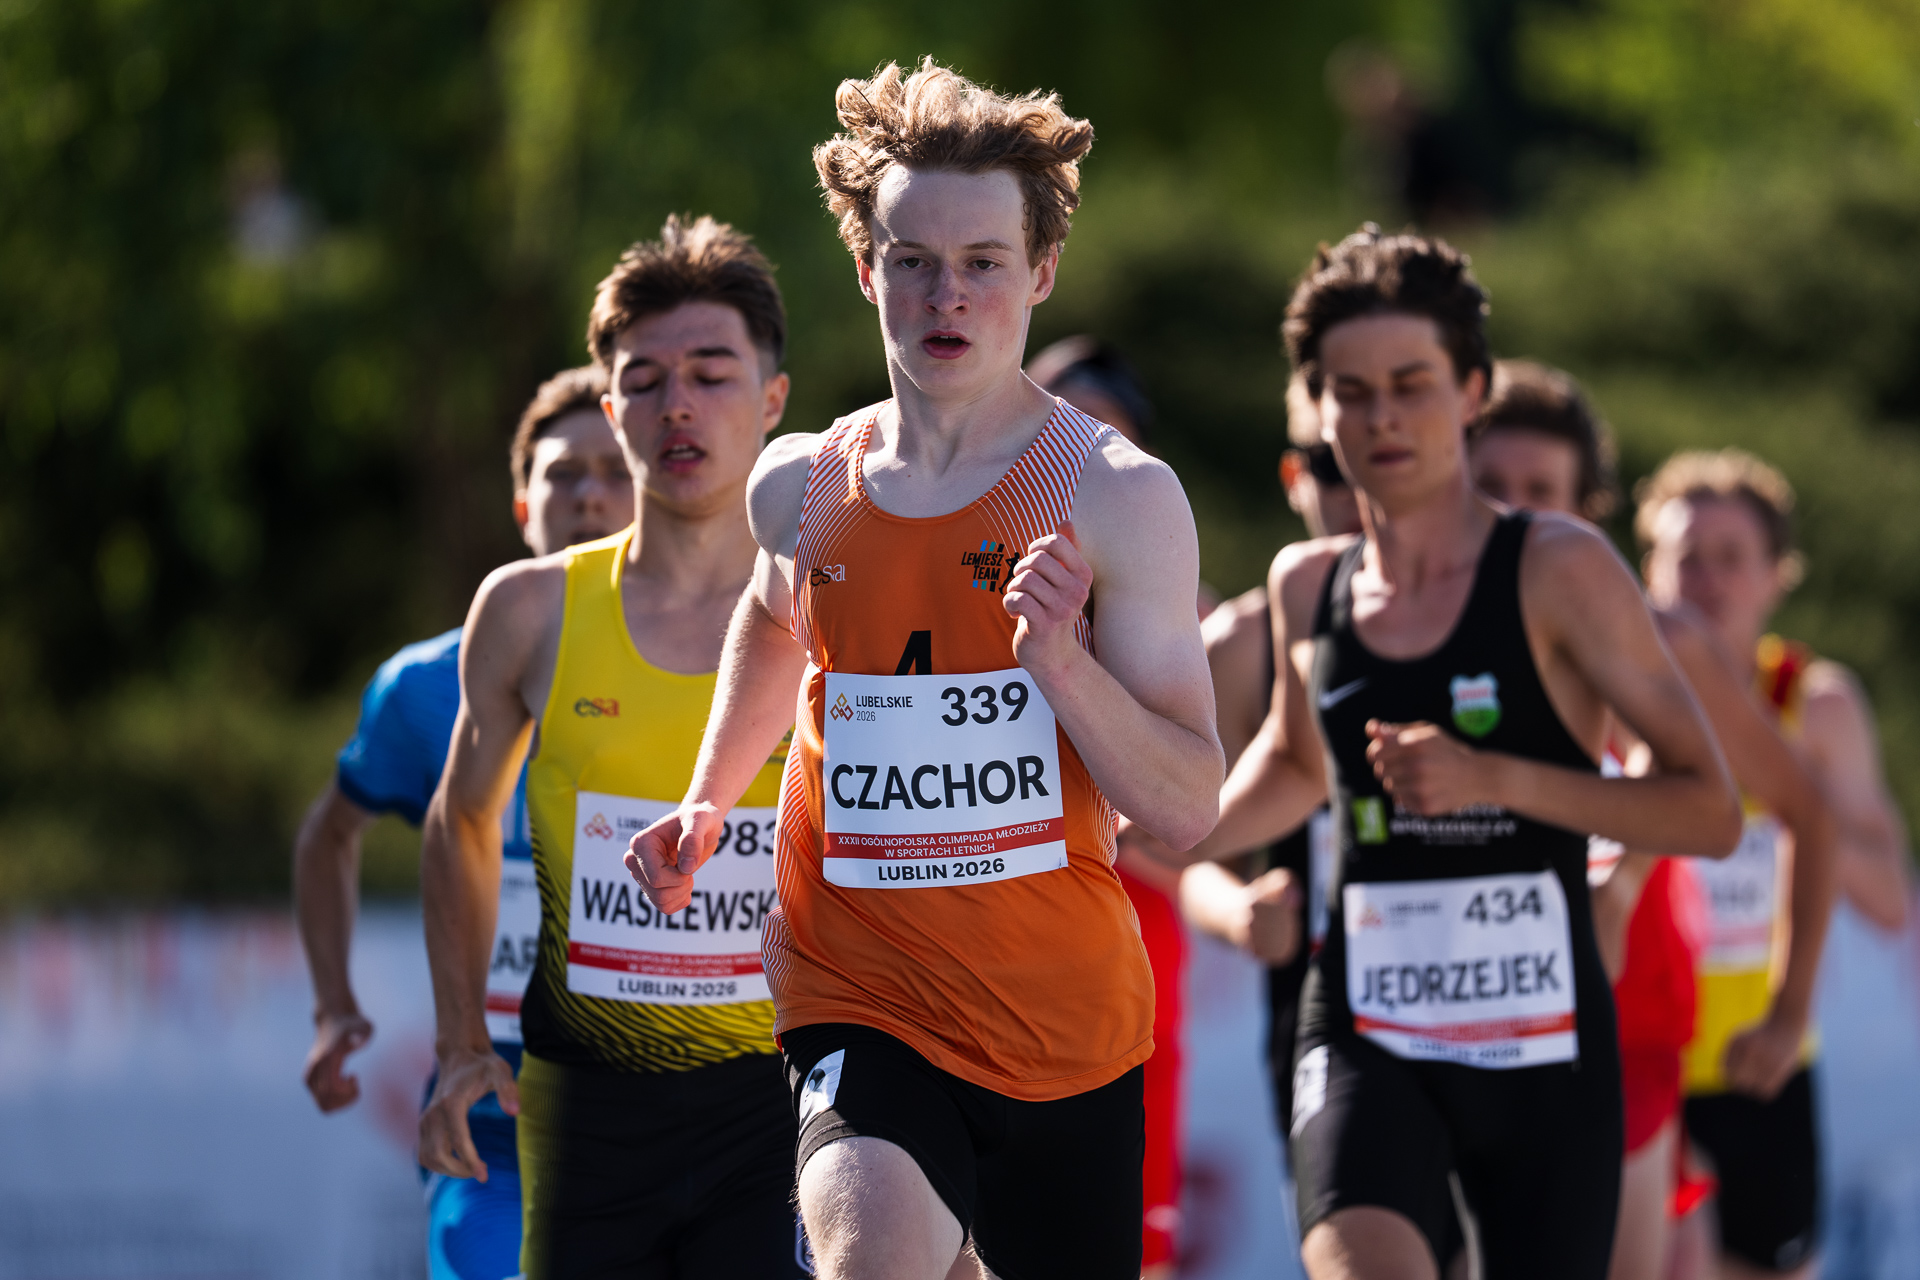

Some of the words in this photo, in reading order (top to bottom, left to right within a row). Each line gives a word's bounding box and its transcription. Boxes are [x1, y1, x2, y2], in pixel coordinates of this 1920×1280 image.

[961, 551, 1005, 567] LEMIESZ
[972, 565, 1001, 581] TEAM
[856, 695, 913, 708] LUBELSKIE
[940, 681, 1029, 727] 339
[856, 710, 876, 722] 2026
[830, 755, 1050, 811] CZACHOR
[838, 836, 860, 846] XXXII
[861, 835, 936, 847] OGÓLNOPOLSKA
[938, 832, 994, 846] OLIMPIADA
[996, 821, 1050, 839] MŁODZIEŻY
[884, 849, 895, 858] W
[897, 847, 951, 858] SPORTACH
[953, 843, 995, 855] LETNICH
[878, 864, 948, 881] LUBLIN
[952, 857, 1005, 878] 2026
[1463, 885, 1545, 927] 434
[617, 978, 687, 997] LUBLIN
[691, 981, 738, 997] 2026
[1360, 950, 1561, 1014] JĘDRZEJEK
